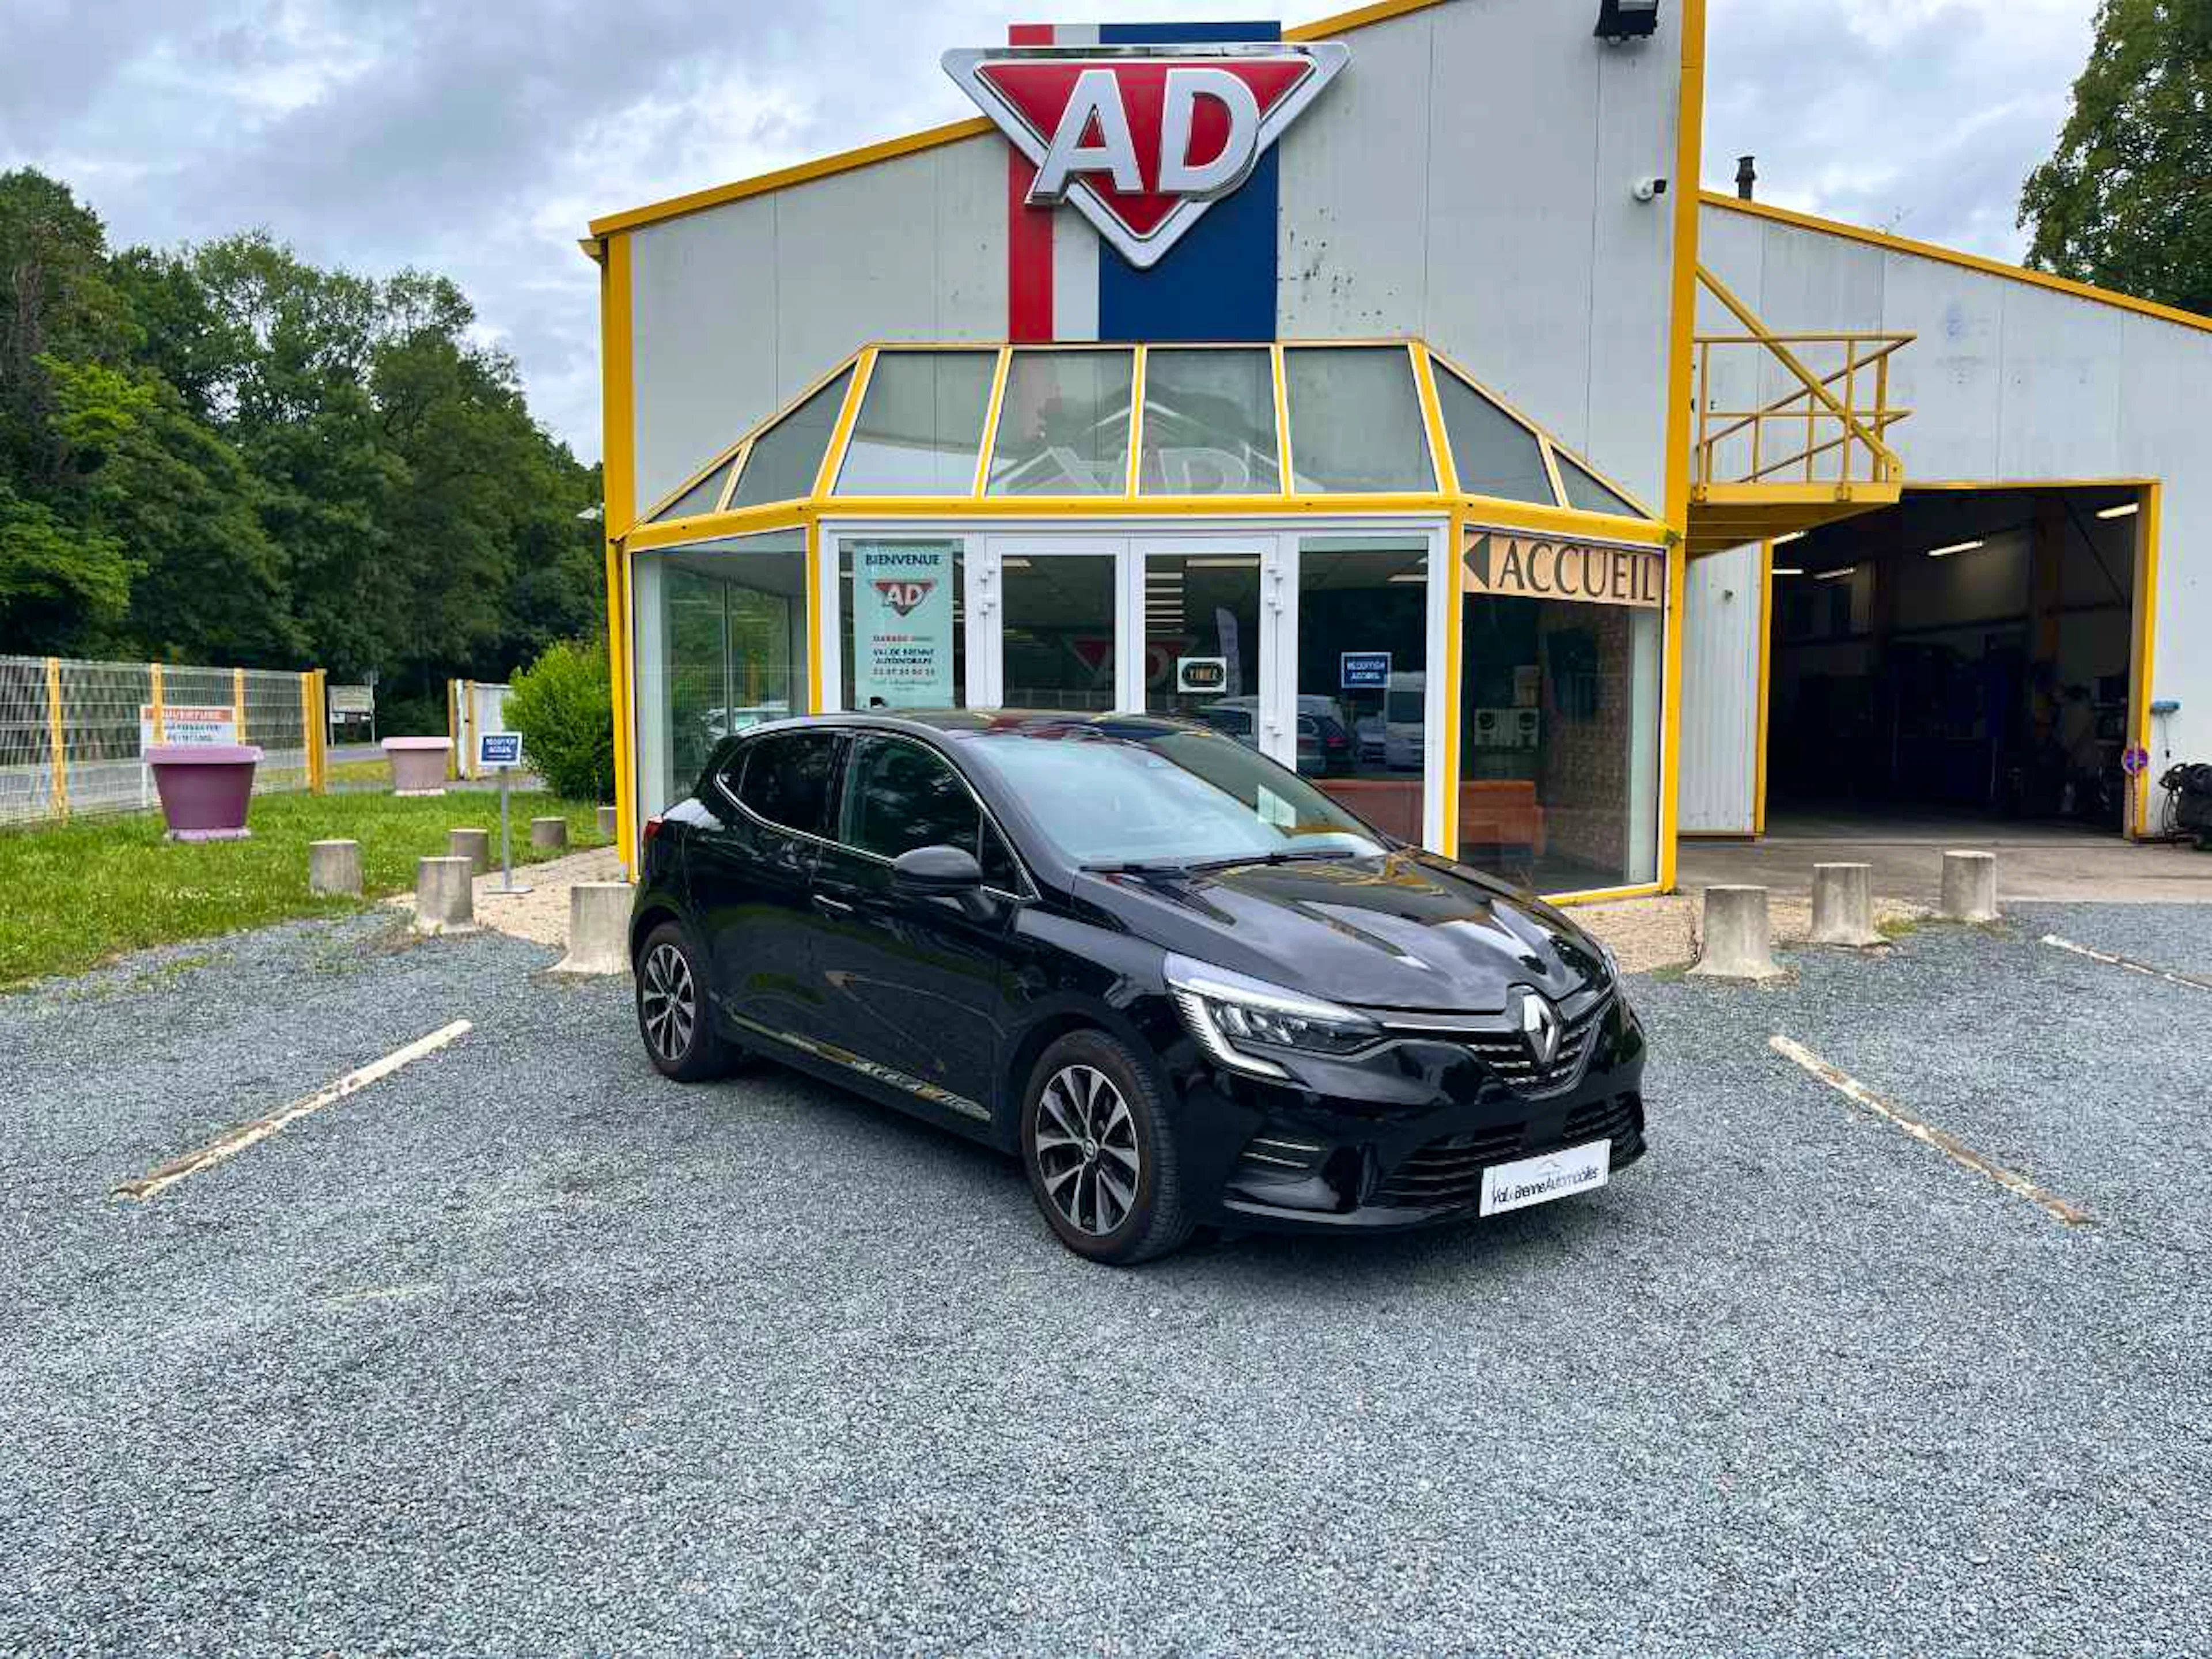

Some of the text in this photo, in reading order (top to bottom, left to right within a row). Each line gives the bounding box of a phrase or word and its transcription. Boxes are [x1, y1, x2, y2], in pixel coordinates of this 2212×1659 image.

[1025, 67, 1260, 204] AD
[866, 554, 940, 565] BIENVENUE
[1499, 539, 1656, 601] ACCUEIL
[884, 583, 924, 607] AD
